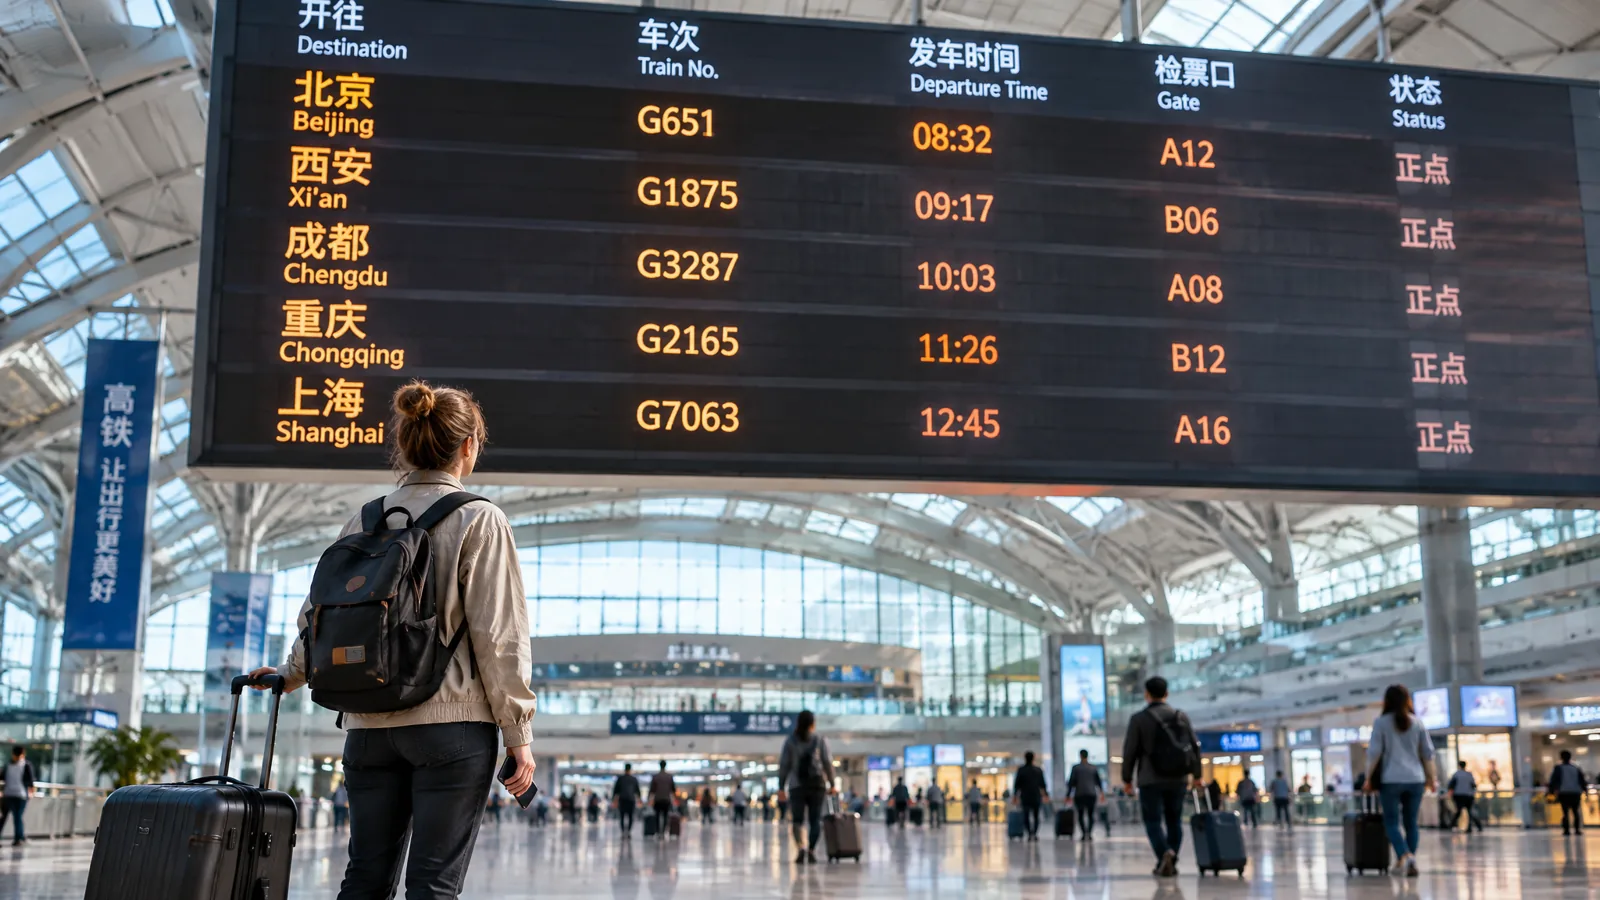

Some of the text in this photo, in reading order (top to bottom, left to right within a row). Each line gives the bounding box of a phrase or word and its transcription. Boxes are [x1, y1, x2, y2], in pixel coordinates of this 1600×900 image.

[298, 0, 365, 31] 开往
[298, 35, 407, 59] Destination
[638, 18, 699, 52] 车次
[638, 56, 719, 79] Train No.
[909, 37, 1020, 74] 发车时间
[1155, 54, 1235, 89] 检票口
[294, 70, 375, 110] 北京
[911, 74, 1048, 101] Departure Time
[1157, 91, 1200, 111] Gate
[1389, 74, 1442, 105] 状态
[294, 110, 374, 139] Beijing
[637, 105, 713, 137] G651
[1392, 109, 1445, 130] Status
[913, 121, 992, 154] 08:32
[1160, 138, 1215, 168] A12
[291, 146, 372, 185] 西安
[1395, 153, 1450, 185] 正点
[288, 187, 347, 209] Xi'an
[637, 176, 738, 209] G1875
[915, 190, 994, 222] 09:17
[1165, 205, 1219, 235] B06
[1400, 218, 1456, 250] 正点
[285, 221, 369, 261] 成都
[284, 262, 387, 290] Chengdu
[637, 249, 738, 281] G3287
[918, 262, 996, 292] 10:03
[1168, 273, 1223, 304] A08
[1406, 284, 1462, 317] 正点
[281, 299, 367, 339] 重庆
[280, 341, 404, 370] Chongqing
[637, 323, 739, 356] G2165
[919, 333, 998, 364] 11:26
[1172, 343, 1226, 373] B12
[1411, 352, 1468, 385] 正点
[278, 377, 364, 418] 上海
[636, 400, 739, 432] G7063
[921, 407, 1000, 438] 12:45
[1175, 415, 1231, 445] A16
[276, 420, 384, 448] Shanghai
[1416, 421, 1473, 454] 正点
[89, 383, 136, 603] 高铁 让出行更美好
